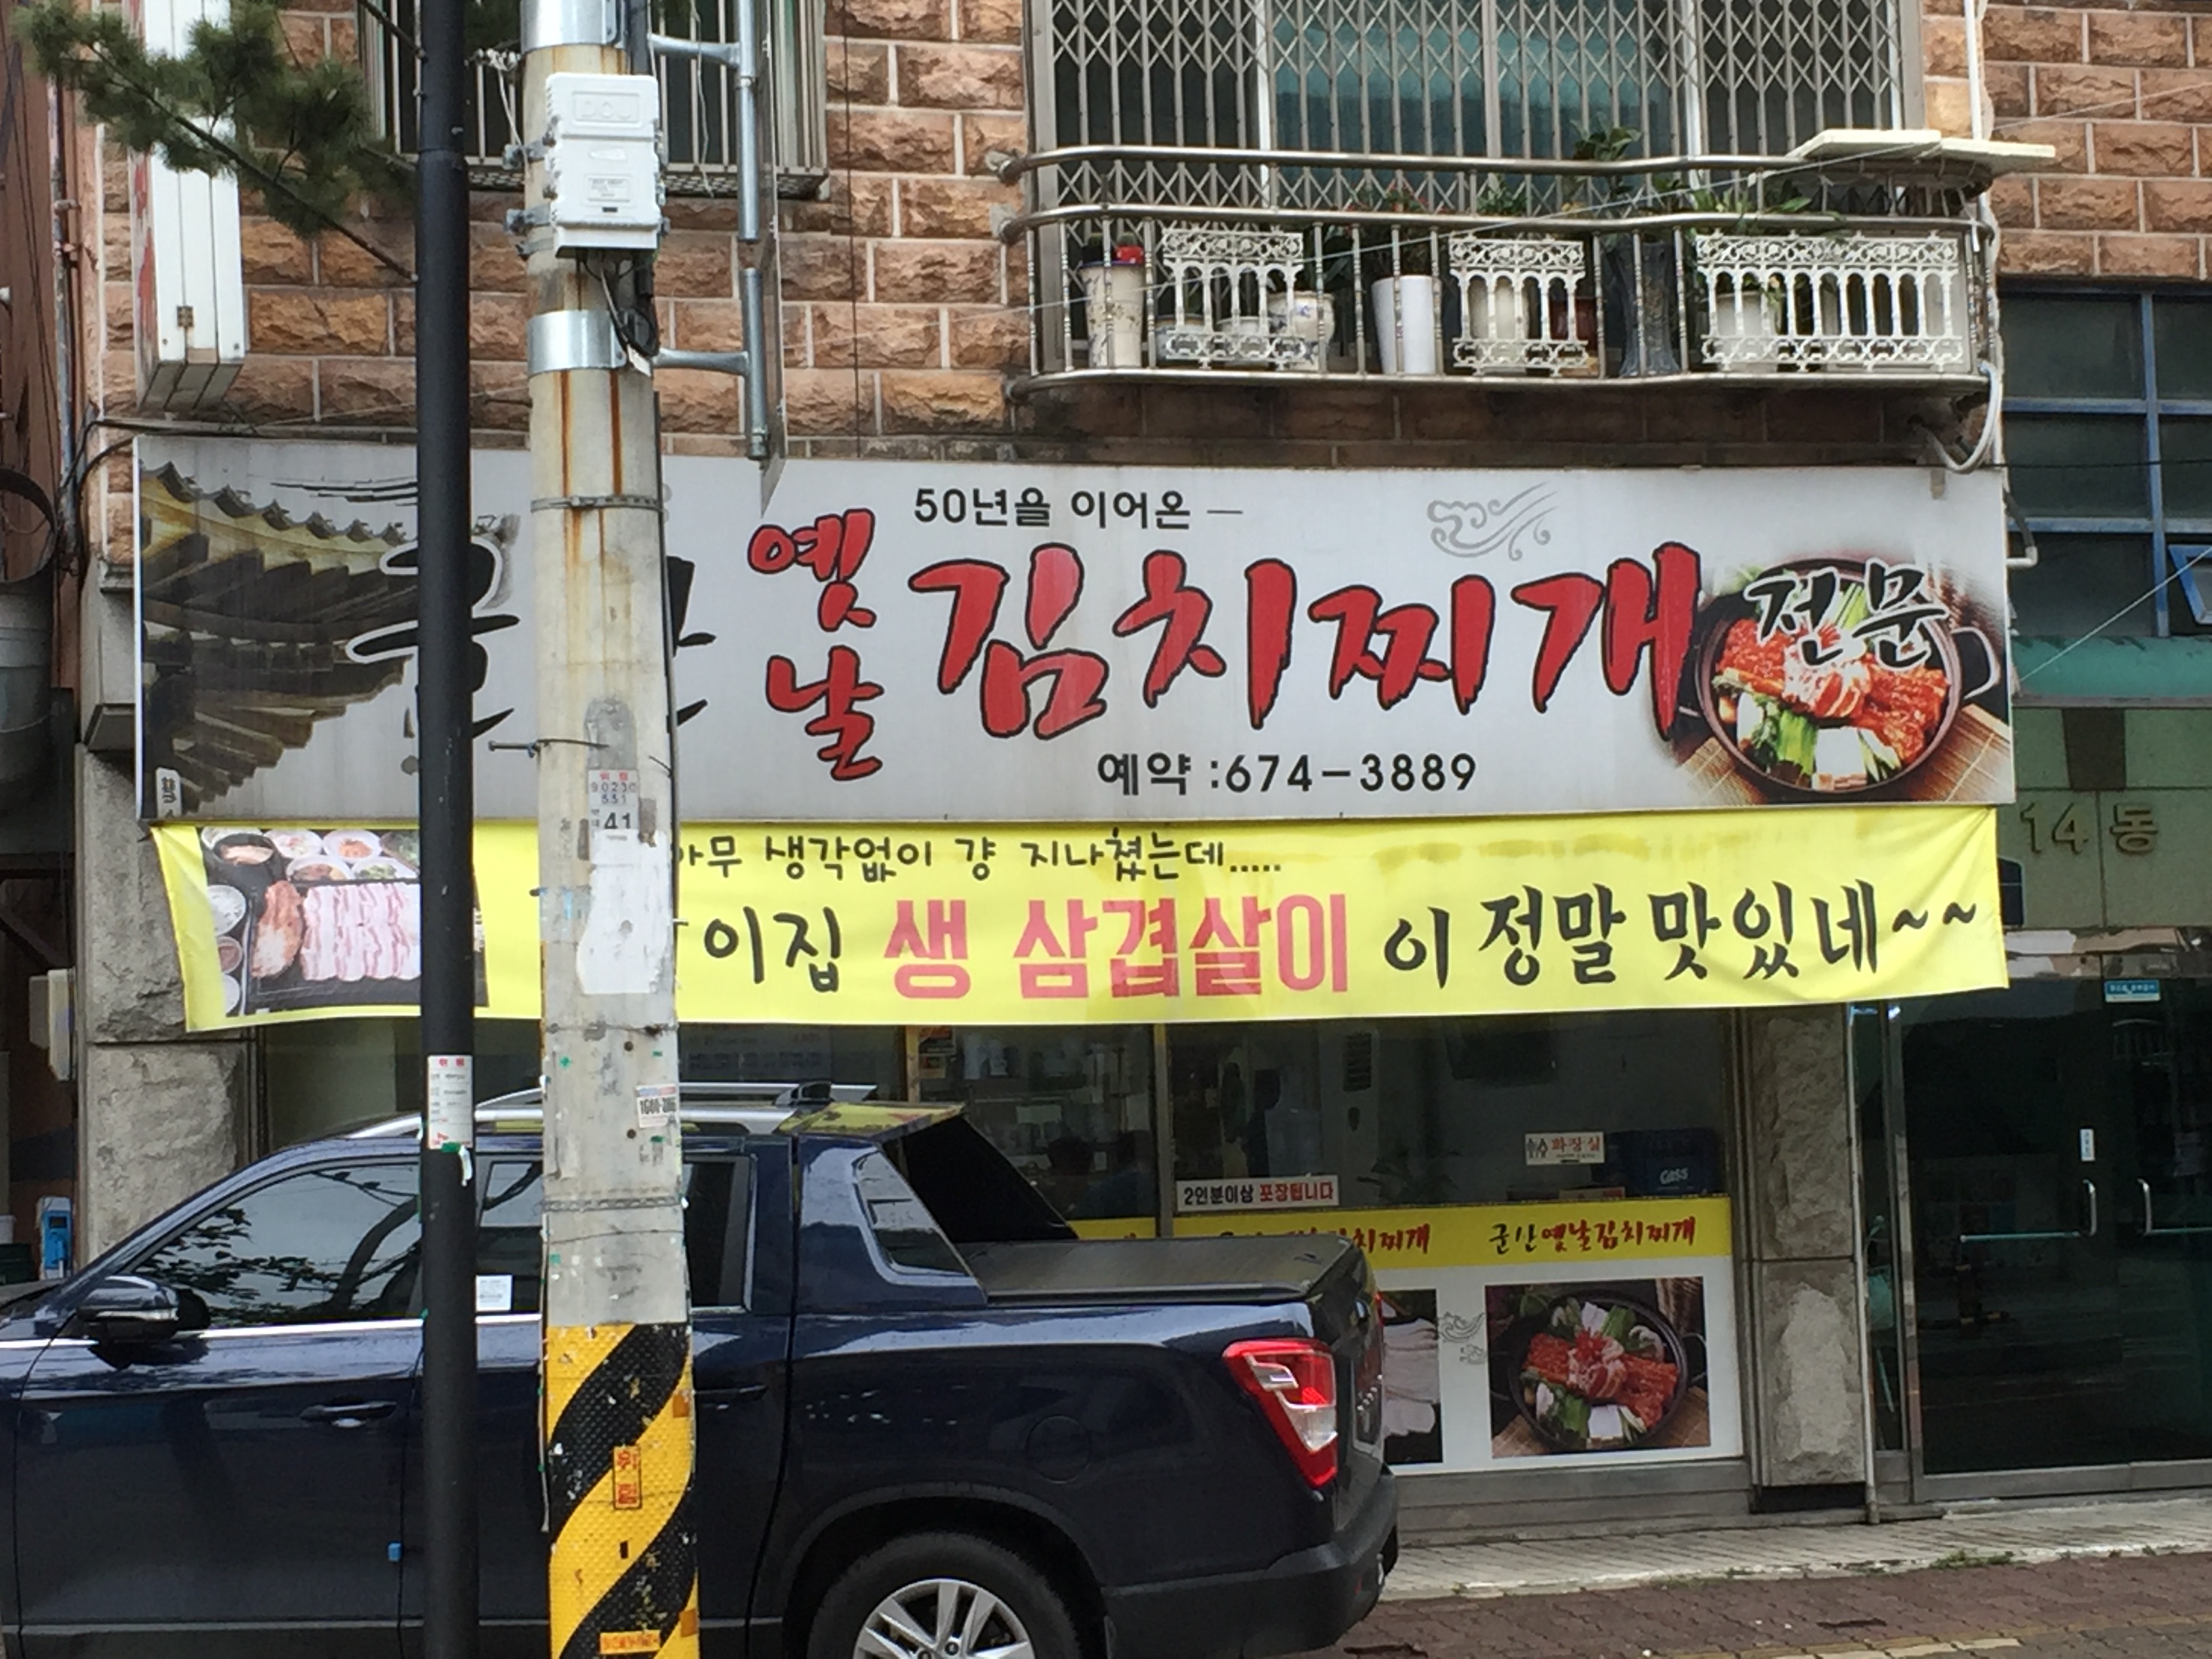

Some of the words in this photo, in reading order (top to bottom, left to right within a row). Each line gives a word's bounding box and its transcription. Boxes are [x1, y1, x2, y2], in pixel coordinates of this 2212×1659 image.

[914, 487, 1050, 527] 50년을
[1071, 491, 1190, 529] 이어온
[747, 508, 884, 781] 옛날
[908, 540, 1702, 740] 김치찌개
[1744, 558, 1948, 668] 전문
[604, 812, 631, 830] 41
[766, 836, 931, 882] 생각없이
[955, 836, 996, 881] 걍
[703, 906, 841, 993] 이집
[884, 899, 970, 998] 생
[1013, 894, 1348, 998] 삼겹살이
[1384, 907, 1450, 989] 이
[1478, 883, 1626, 986] 정말
[1551, 1136, 1600, 1153] 화장실
[1184, 1184, 1254, 1206] 2인분이상
[1260, 1181, 1334, 1203] 포장됩니다
